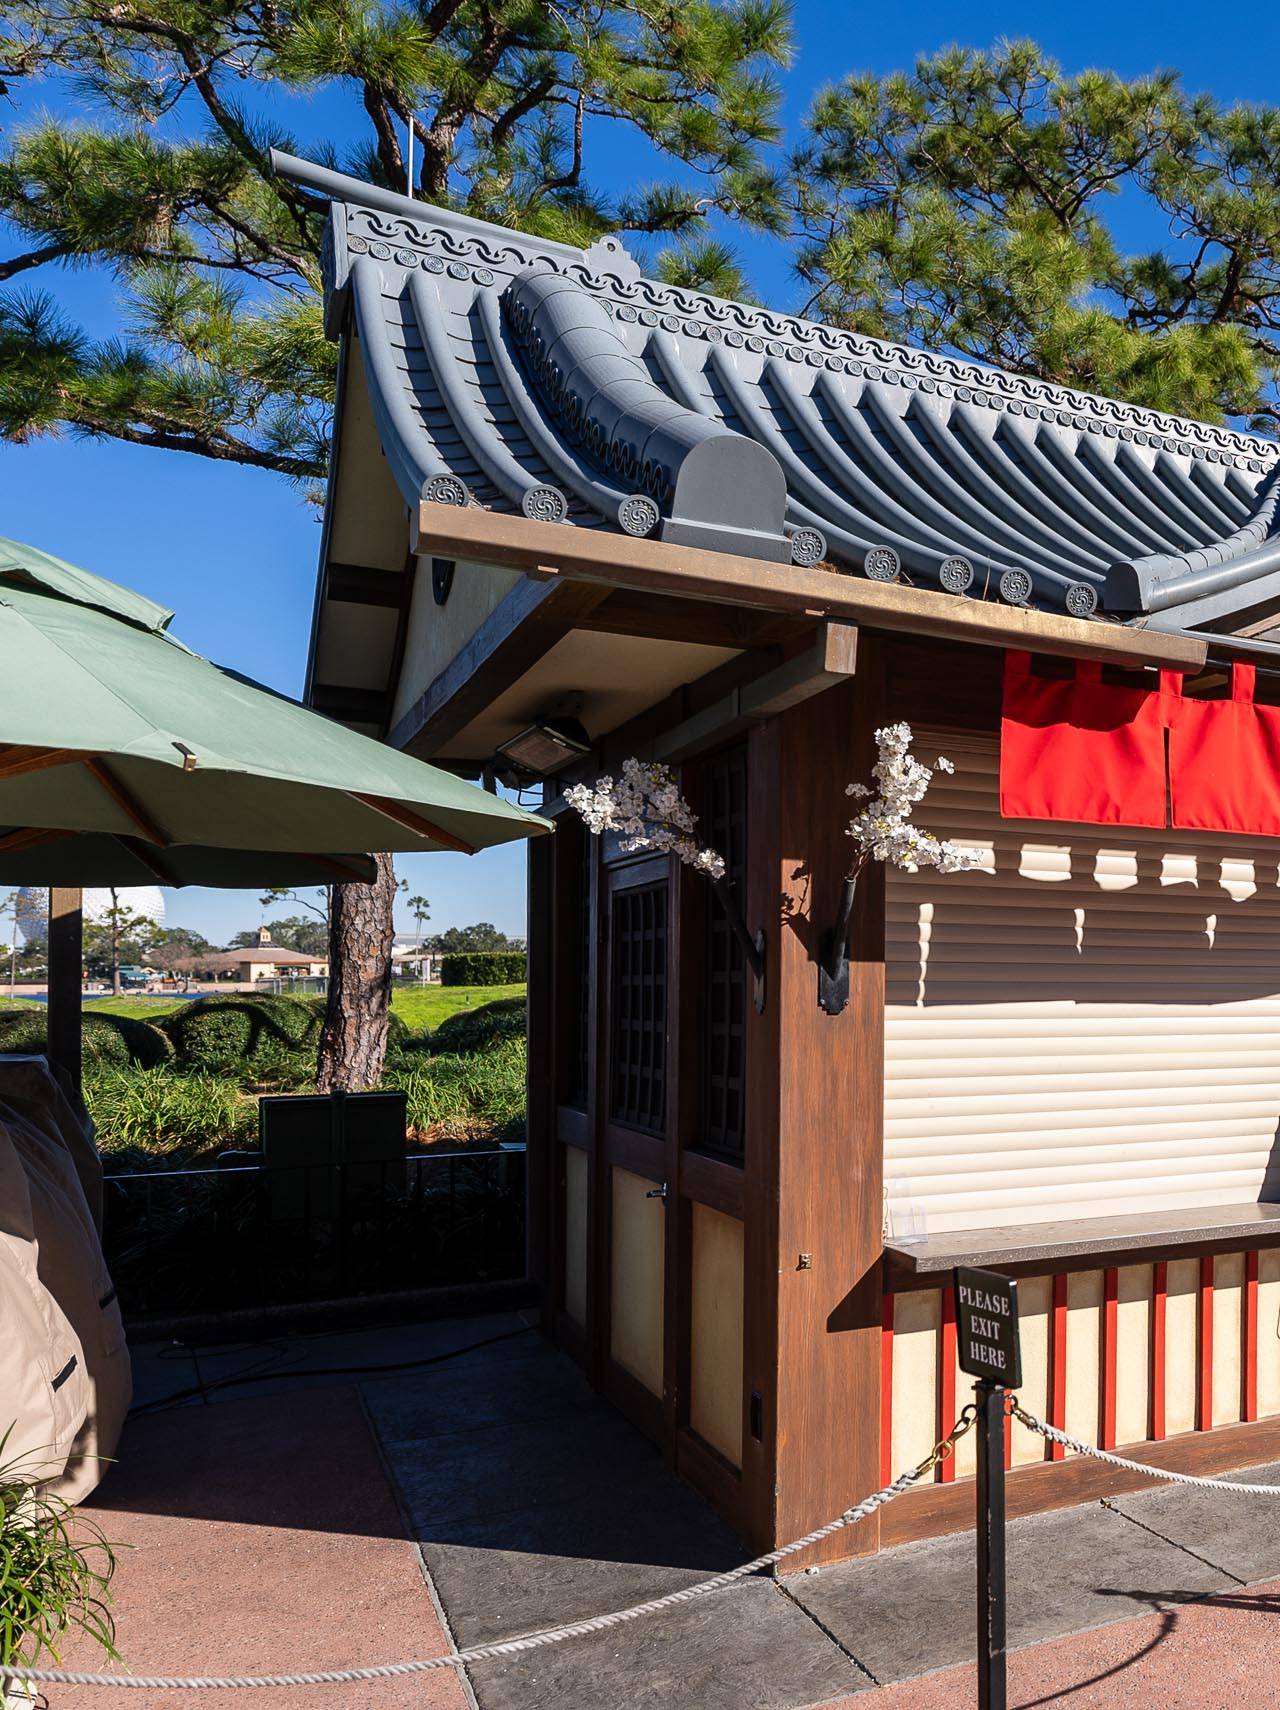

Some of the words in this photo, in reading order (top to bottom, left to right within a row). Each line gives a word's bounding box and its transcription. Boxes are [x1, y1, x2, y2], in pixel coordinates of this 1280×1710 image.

[959, 1285, 1010, 1317] PLEASE
[970, 1315, 1000, 1340] EXIT
[970, 1341, 1007, 1369] HERE
